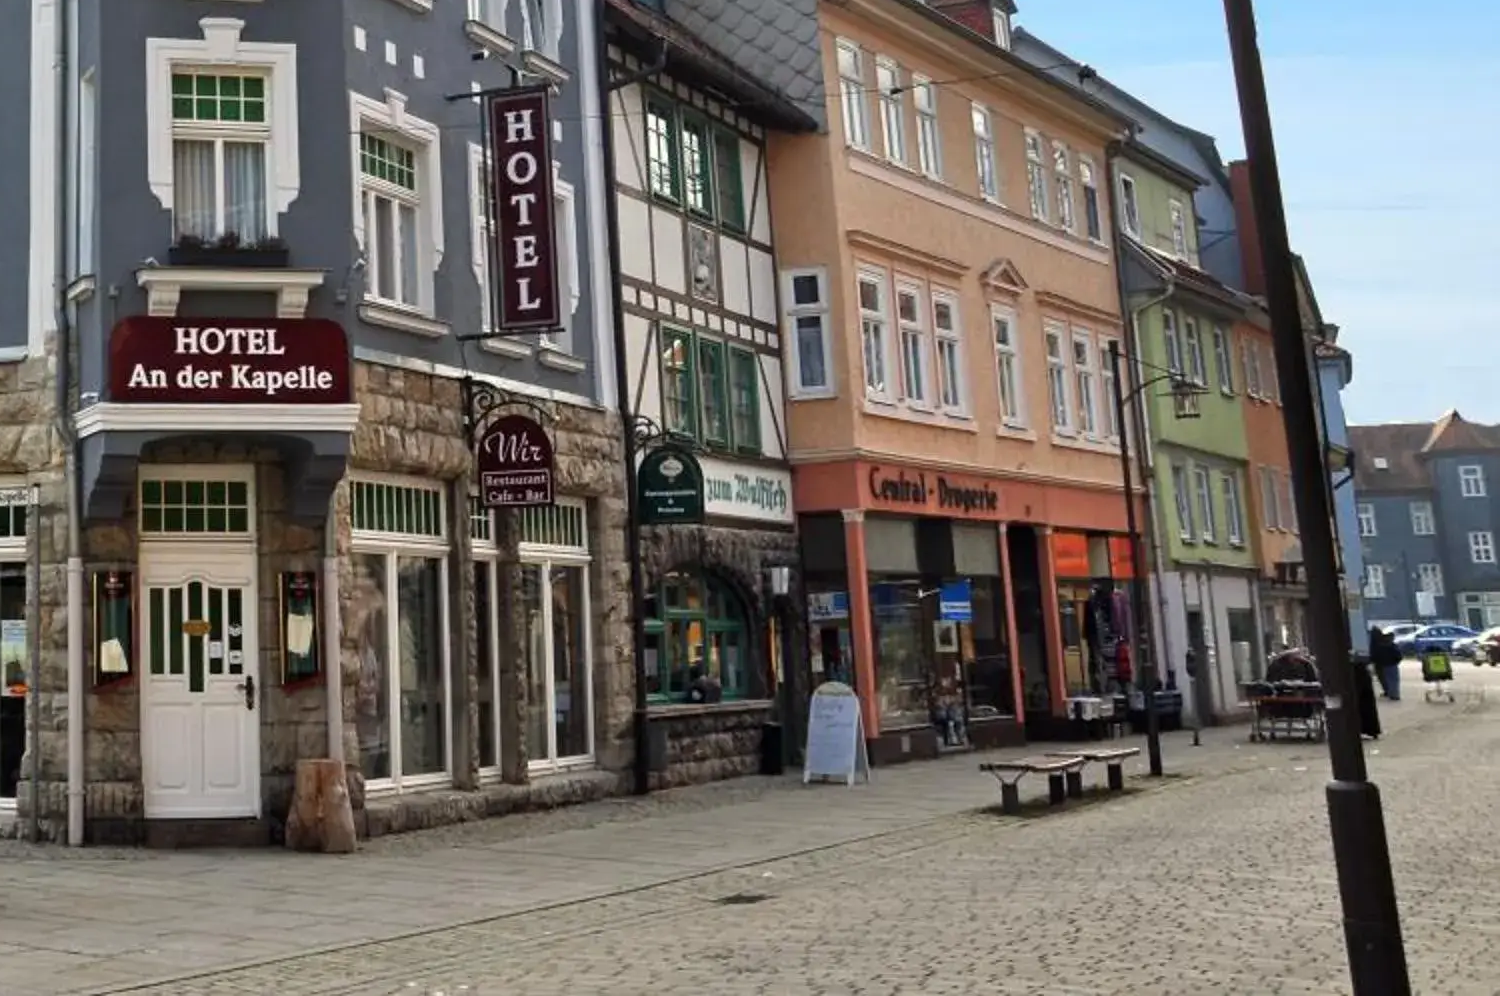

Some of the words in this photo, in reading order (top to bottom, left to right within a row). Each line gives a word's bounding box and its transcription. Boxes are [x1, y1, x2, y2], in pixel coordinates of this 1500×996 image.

[504, 109, 541, 311] HOTEL
[174, 327, 285, 355] HOTEL
[128, 363, 168, 389] An
[177, 364, 223, 389] der
[230, 365, 333, 395] Kapelle
[485, 474, 546, 486] Restaurant
[525, 489, 546, 501] Bar
[869, 466, 927, 505] Central
[937, 475, 998, 513] Drogerie
